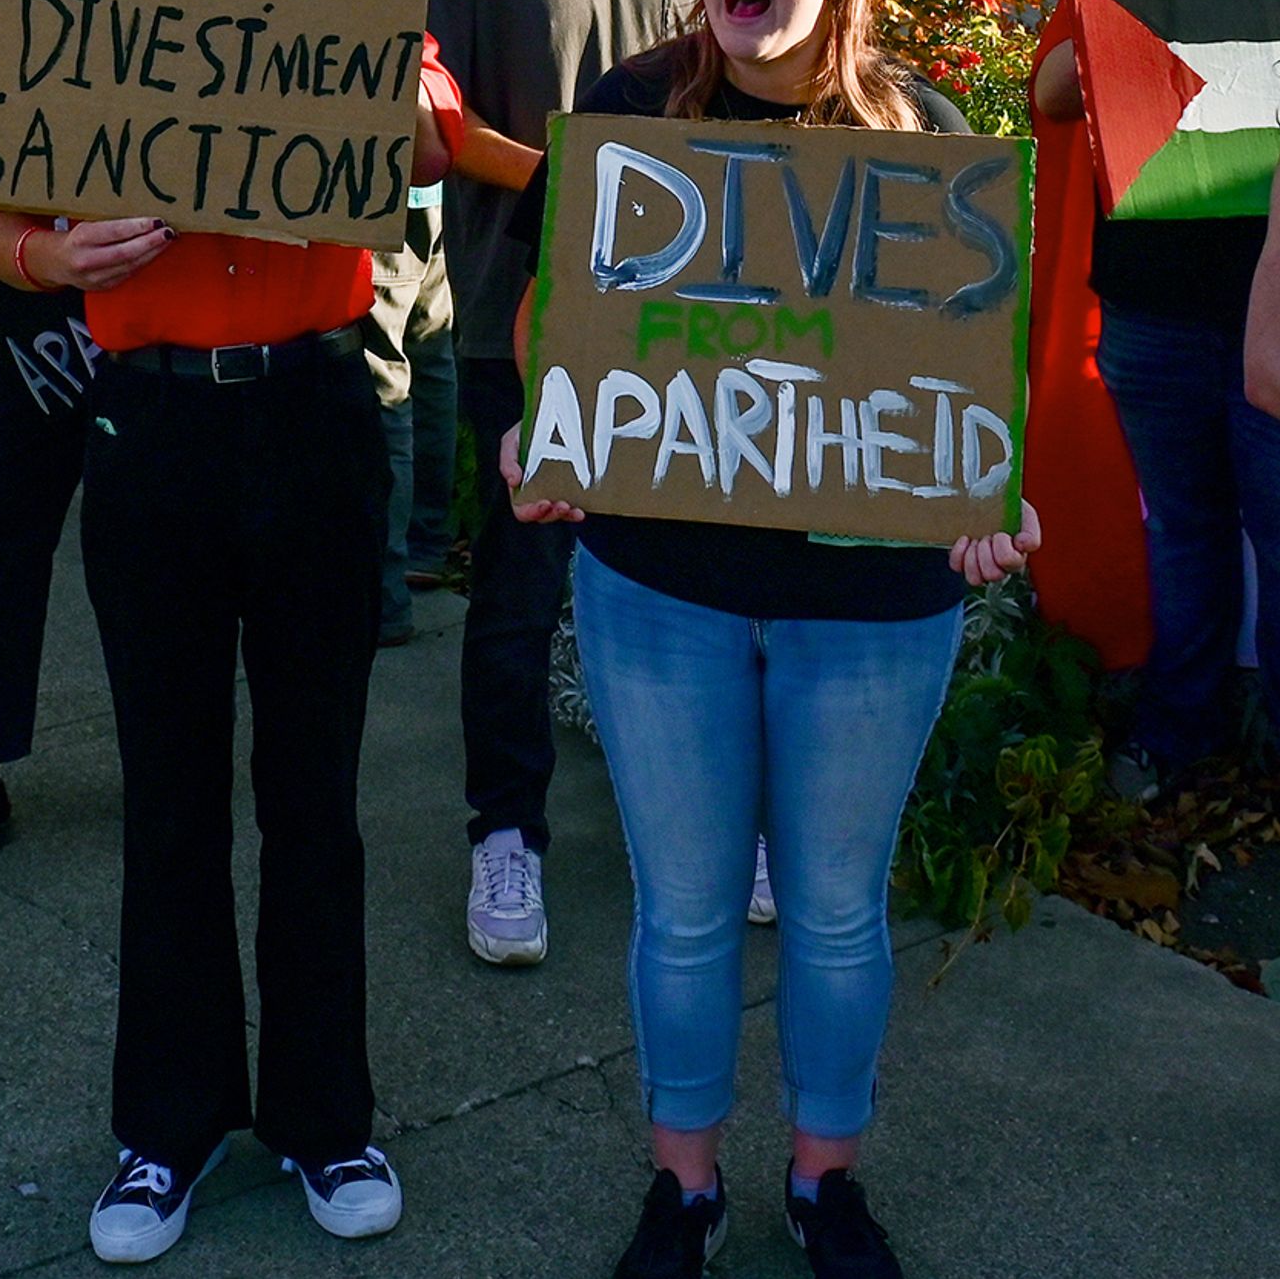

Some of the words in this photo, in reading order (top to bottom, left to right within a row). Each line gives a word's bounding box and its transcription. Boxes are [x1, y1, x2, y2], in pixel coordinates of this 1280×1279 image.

[590, 138, 1019, 319] DIVES
[635, 300, 835, 361] FROM
[520, 356, 1014, 500] APARTHEID
